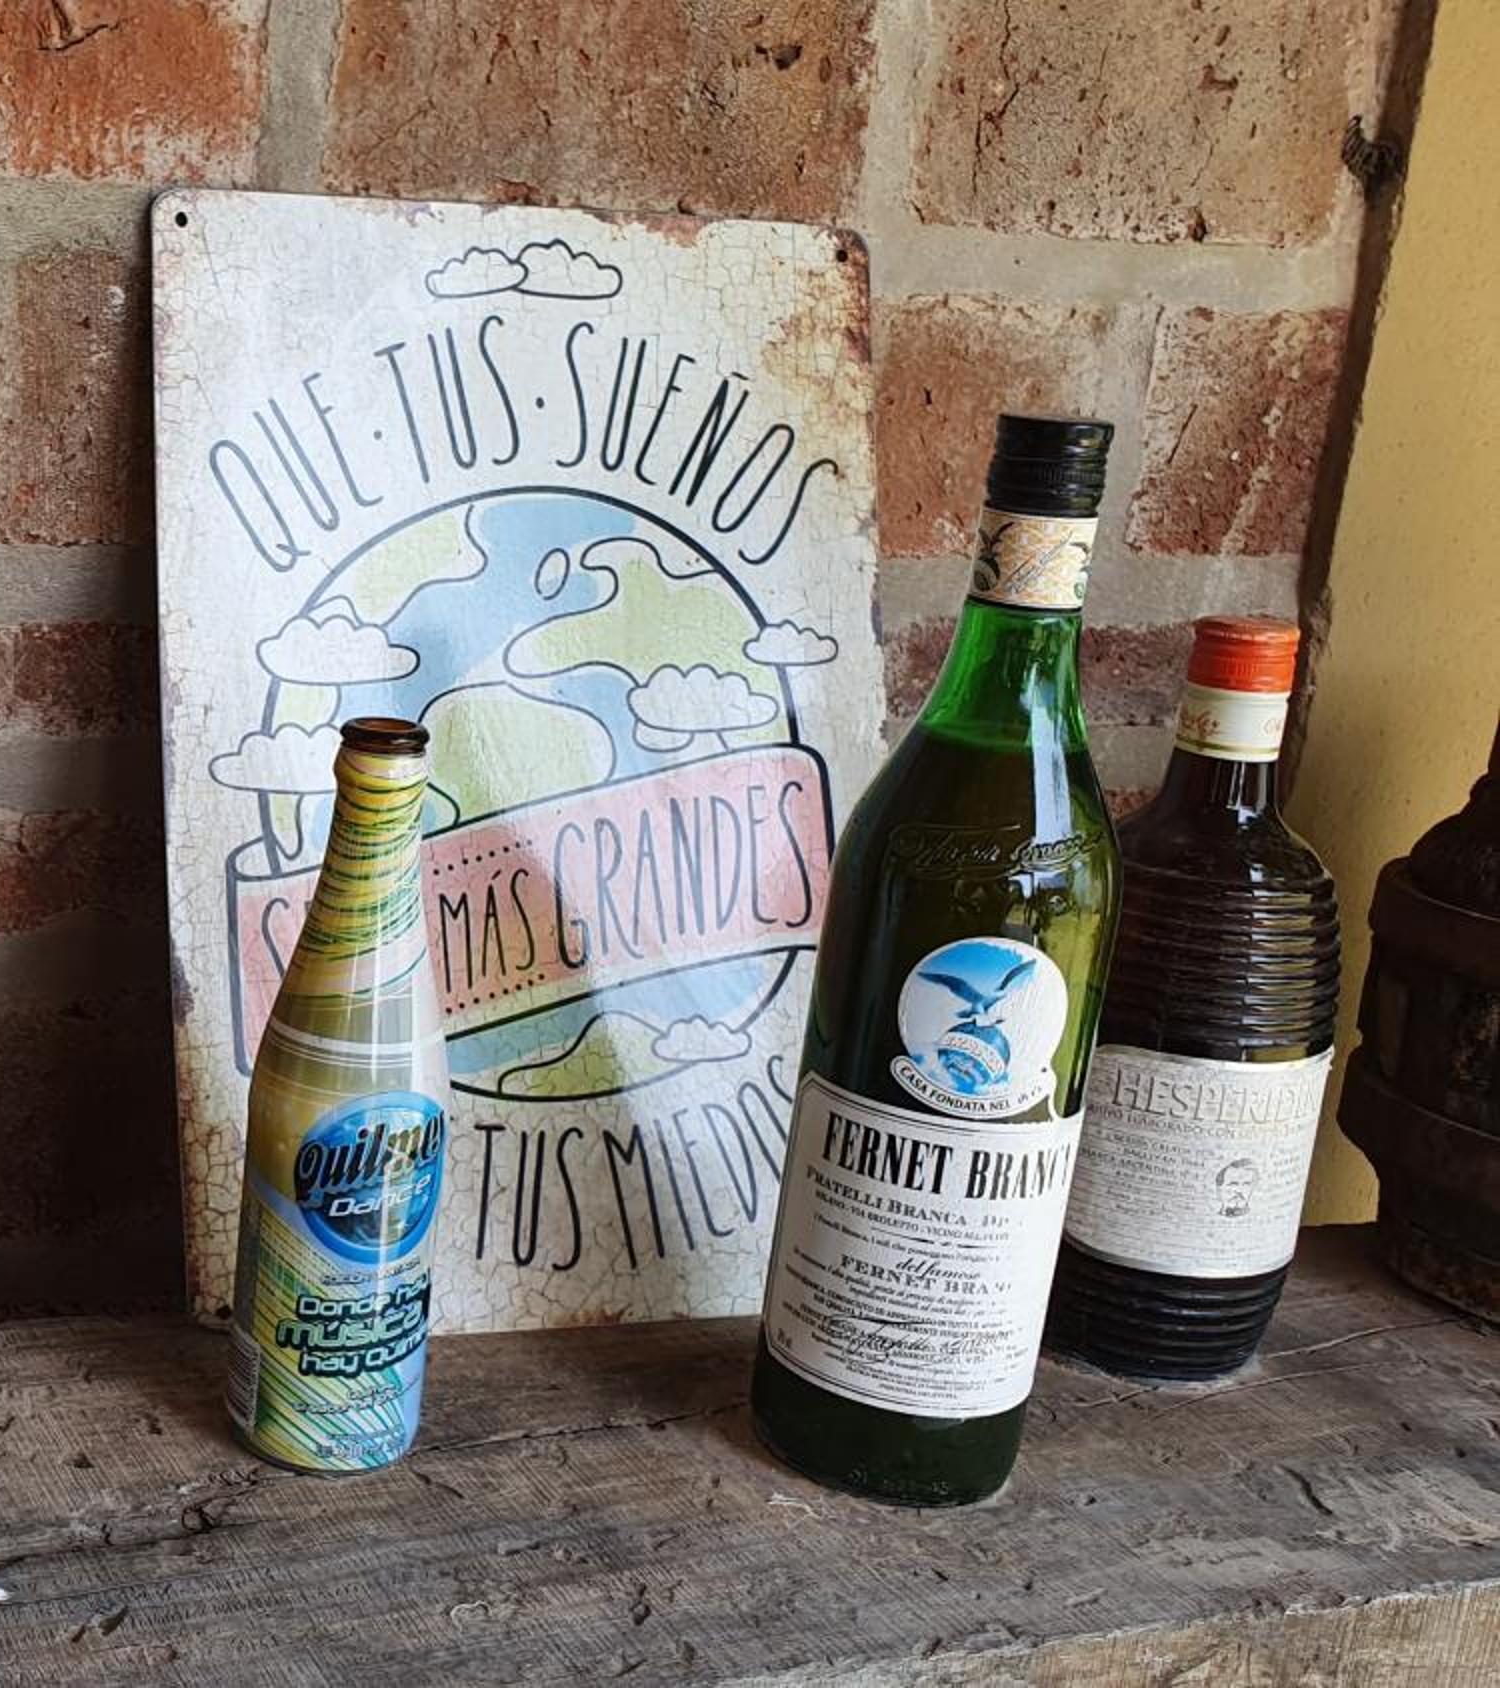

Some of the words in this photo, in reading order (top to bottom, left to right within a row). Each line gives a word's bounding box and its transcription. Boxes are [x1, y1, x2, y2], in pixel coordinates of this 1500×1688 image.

[210, 373, 383, 572] QUE
[374, 316, 519, 484] TUS
[556, 321, 839, 564] SUEÑOS
[437, 868, 537, 994] MÁS
[553, 781, 813, 969] GRANDES
[900, 1065, 928, 1094] CASA
[821, 1109, 954, 1195] FERNET
[328, 1173, 432, 1217] Dance
[474, 1122, 585, 1271] TUS
[806, 1164, 883, 1210] FRATELLI
[887, 1199, 967, 1226] BRANCA
[840, 1253, 938, 1291] FERNET
